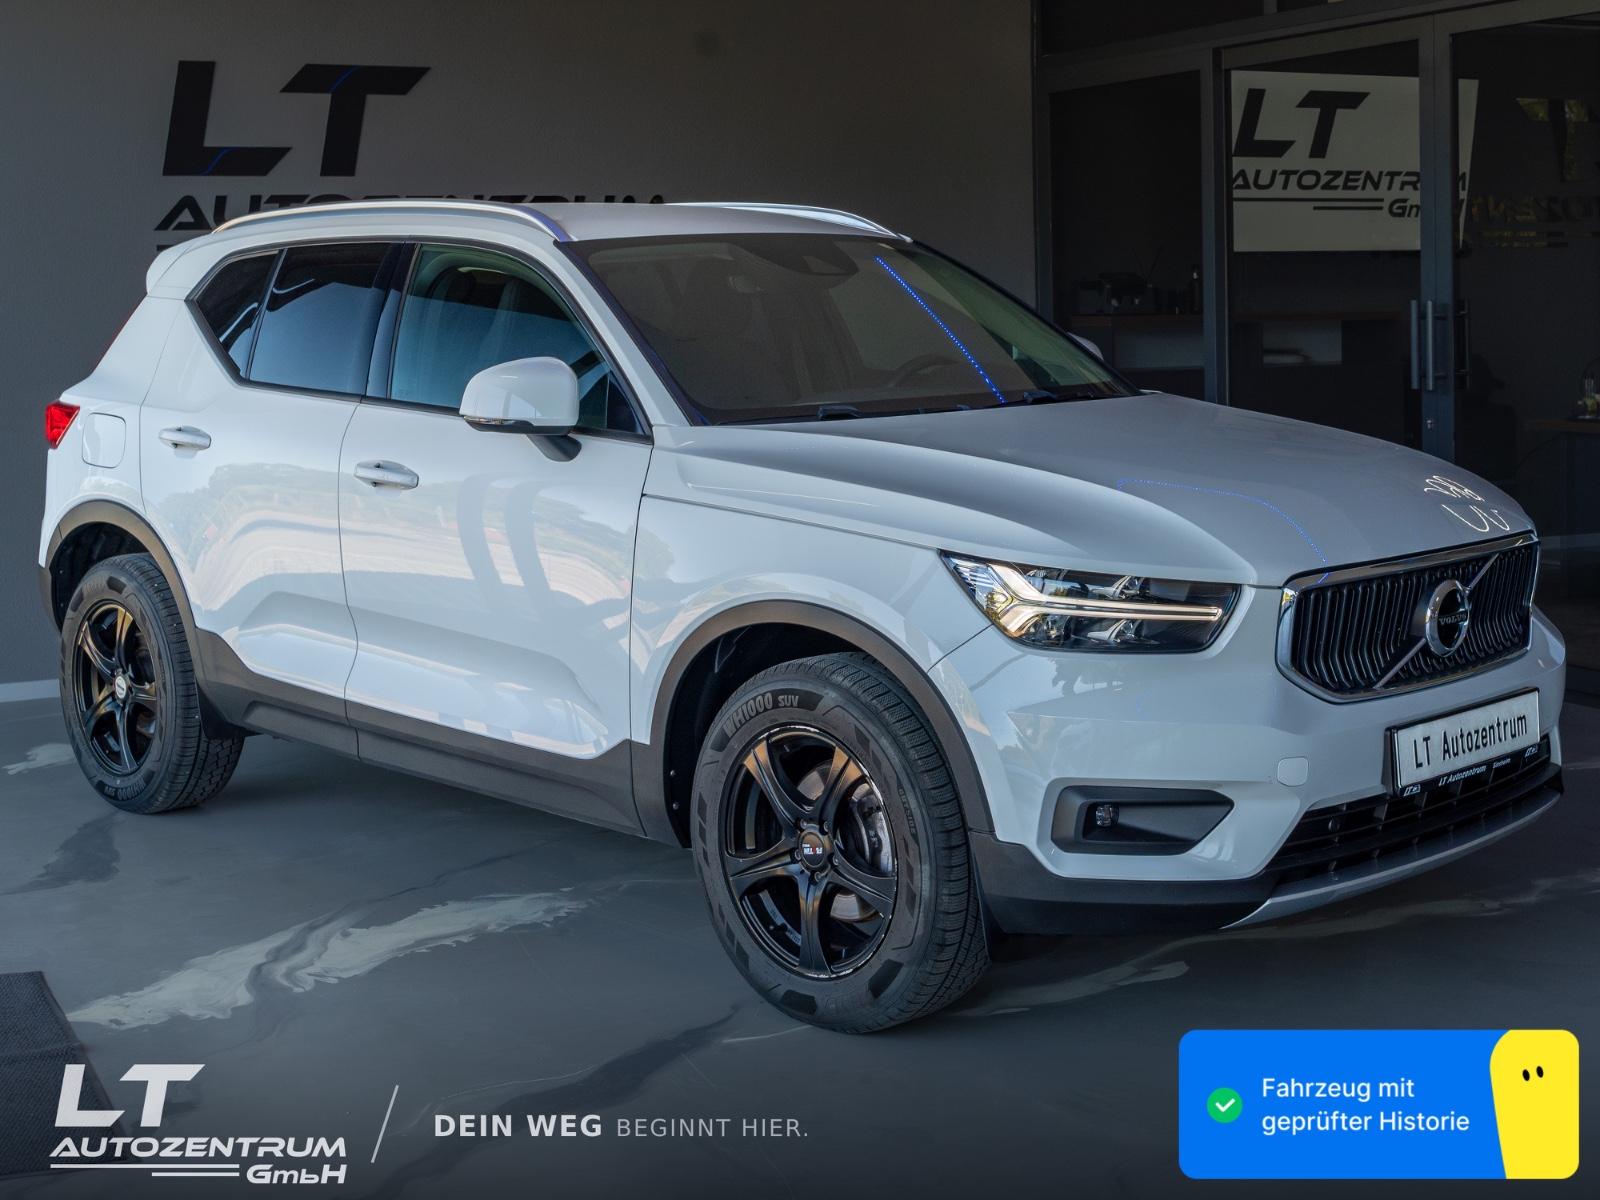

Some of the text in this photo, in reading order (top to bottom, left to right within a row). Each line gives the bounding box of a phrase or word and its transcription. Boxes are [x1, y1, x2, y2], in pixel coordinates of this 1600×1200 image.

[162, 60, 431, 177] LT
[1232, 88, 1371, 159] LT
[1232, 169, 1467, 191] AUTOZENTR
[1439, 613, 1467, 625] VOLVO
[722, 692, 800, 738] WH1000 SUV
[1413, 714, 1527, 769] LT Autozentrum
[1438, 776, 1447, 787] LT
[1447, 765, 1487, 783] Autozentrum
